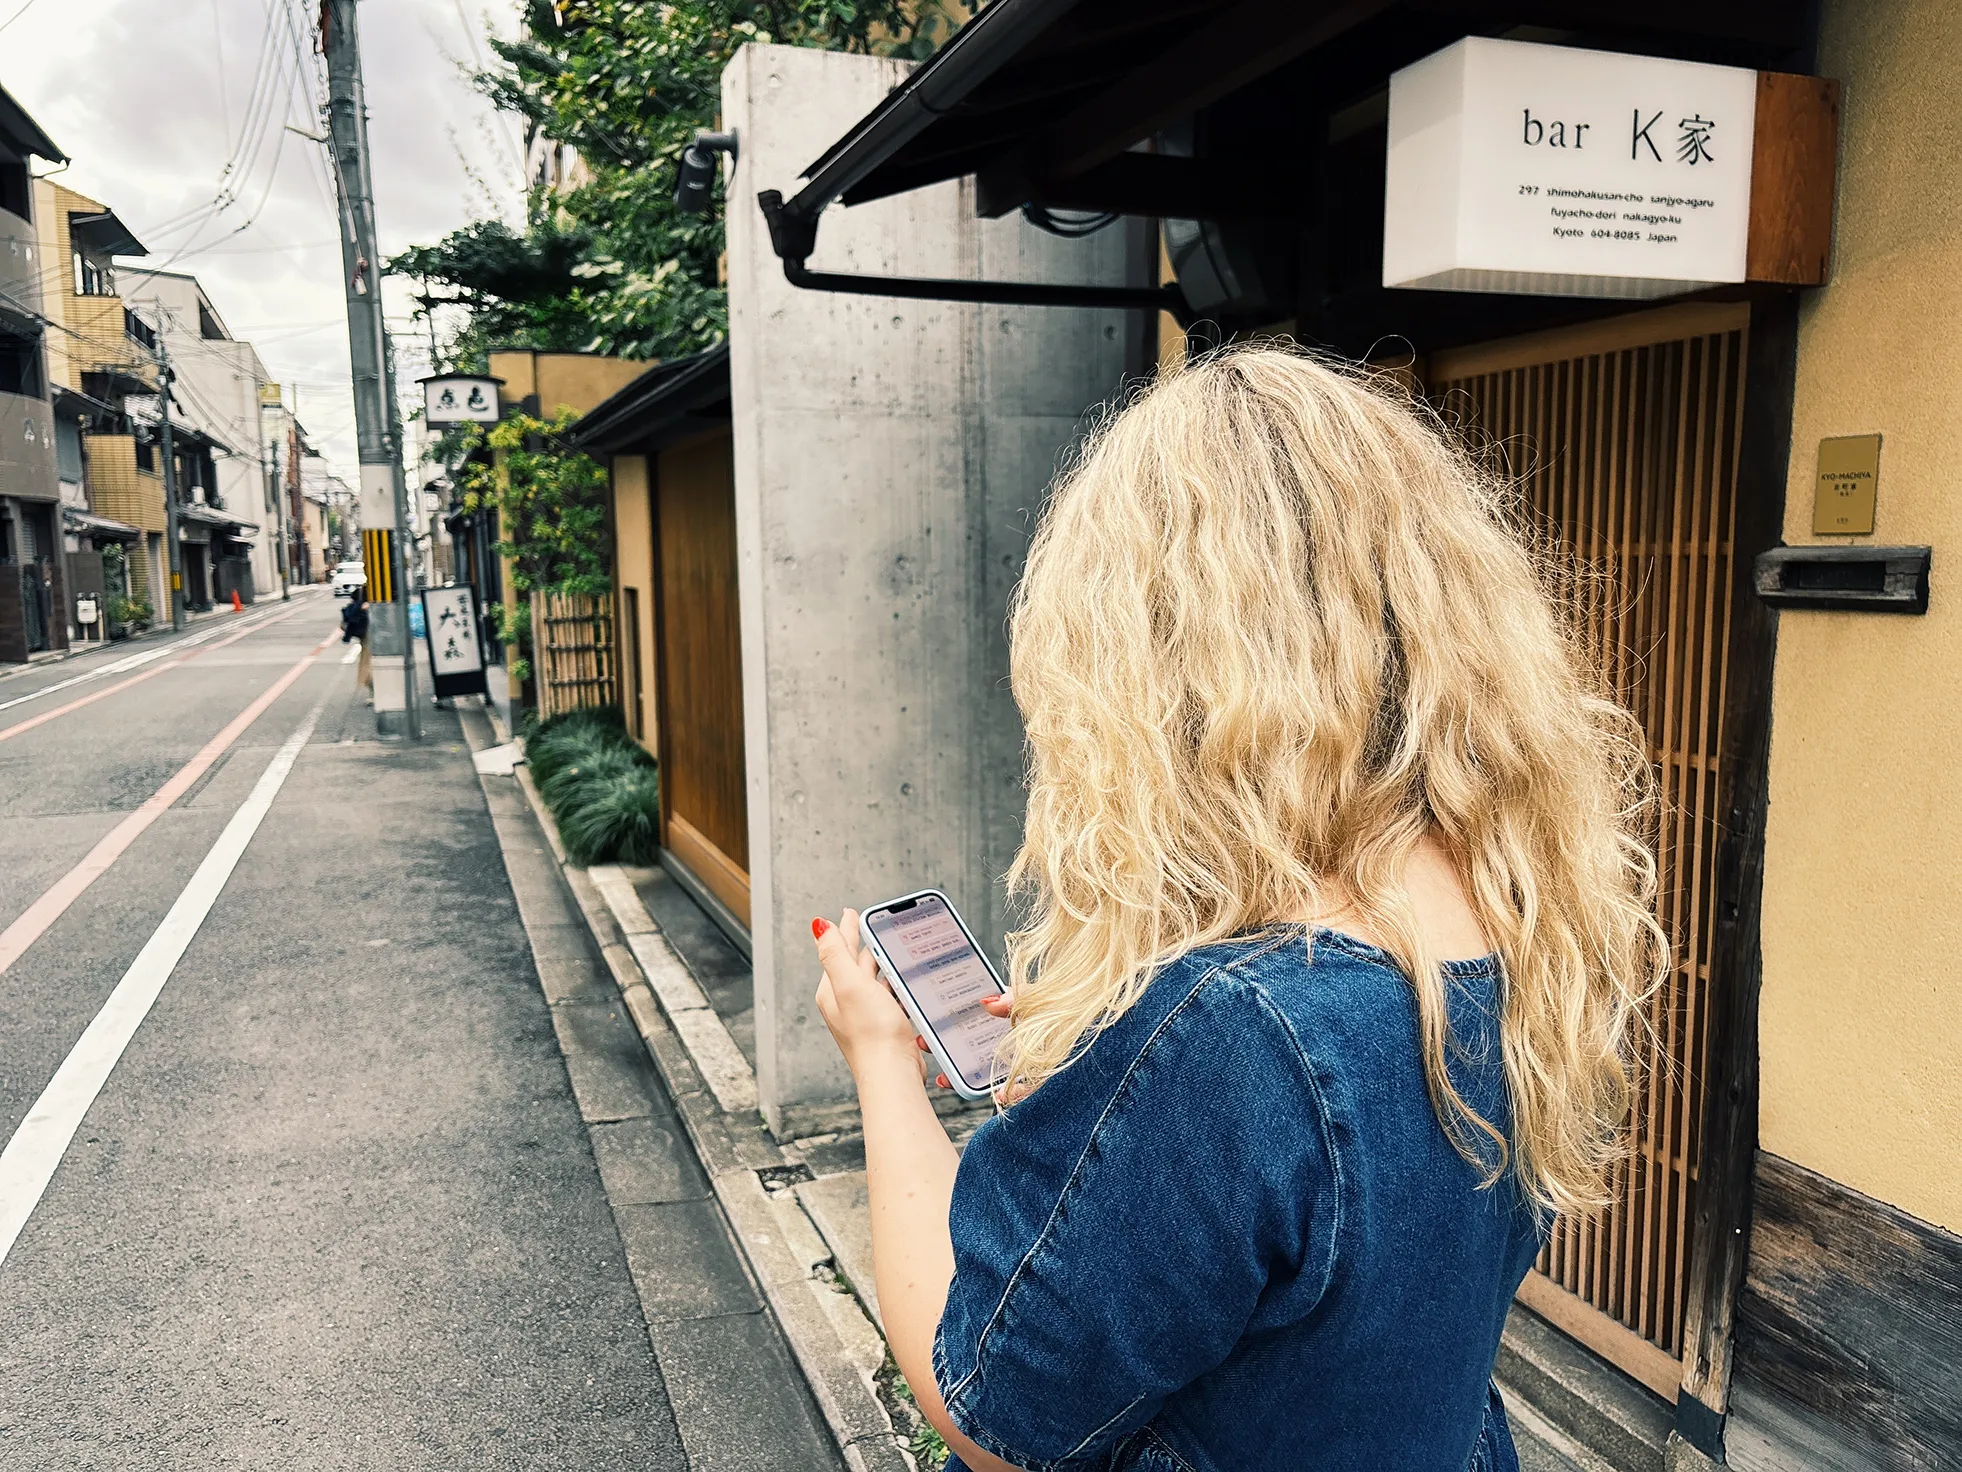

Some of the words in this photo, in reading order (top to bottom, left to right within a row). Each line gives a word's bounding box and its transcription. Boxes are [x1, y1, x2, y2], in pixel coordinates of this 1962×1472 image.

[1522, 108, 1590, 149] bar
[1518, 184, 1540, 196] 297
[1546, 187, 1643, 203] shimohakusan-cho
[1650, 195, 1714, 209] sanjyo-agaru
[1550, 205, 1617, 220] fuyacho-dori
[1622, 211, 1683, 225] nakagyo-ku
[1552, 226, 1584, 239] Kyoto
[1590, 228, 1641, 241] 604-8085
[1646, 233, 1678, 244] Japan
[1821, 471, 1872, 481] KYO-MACHIYA
